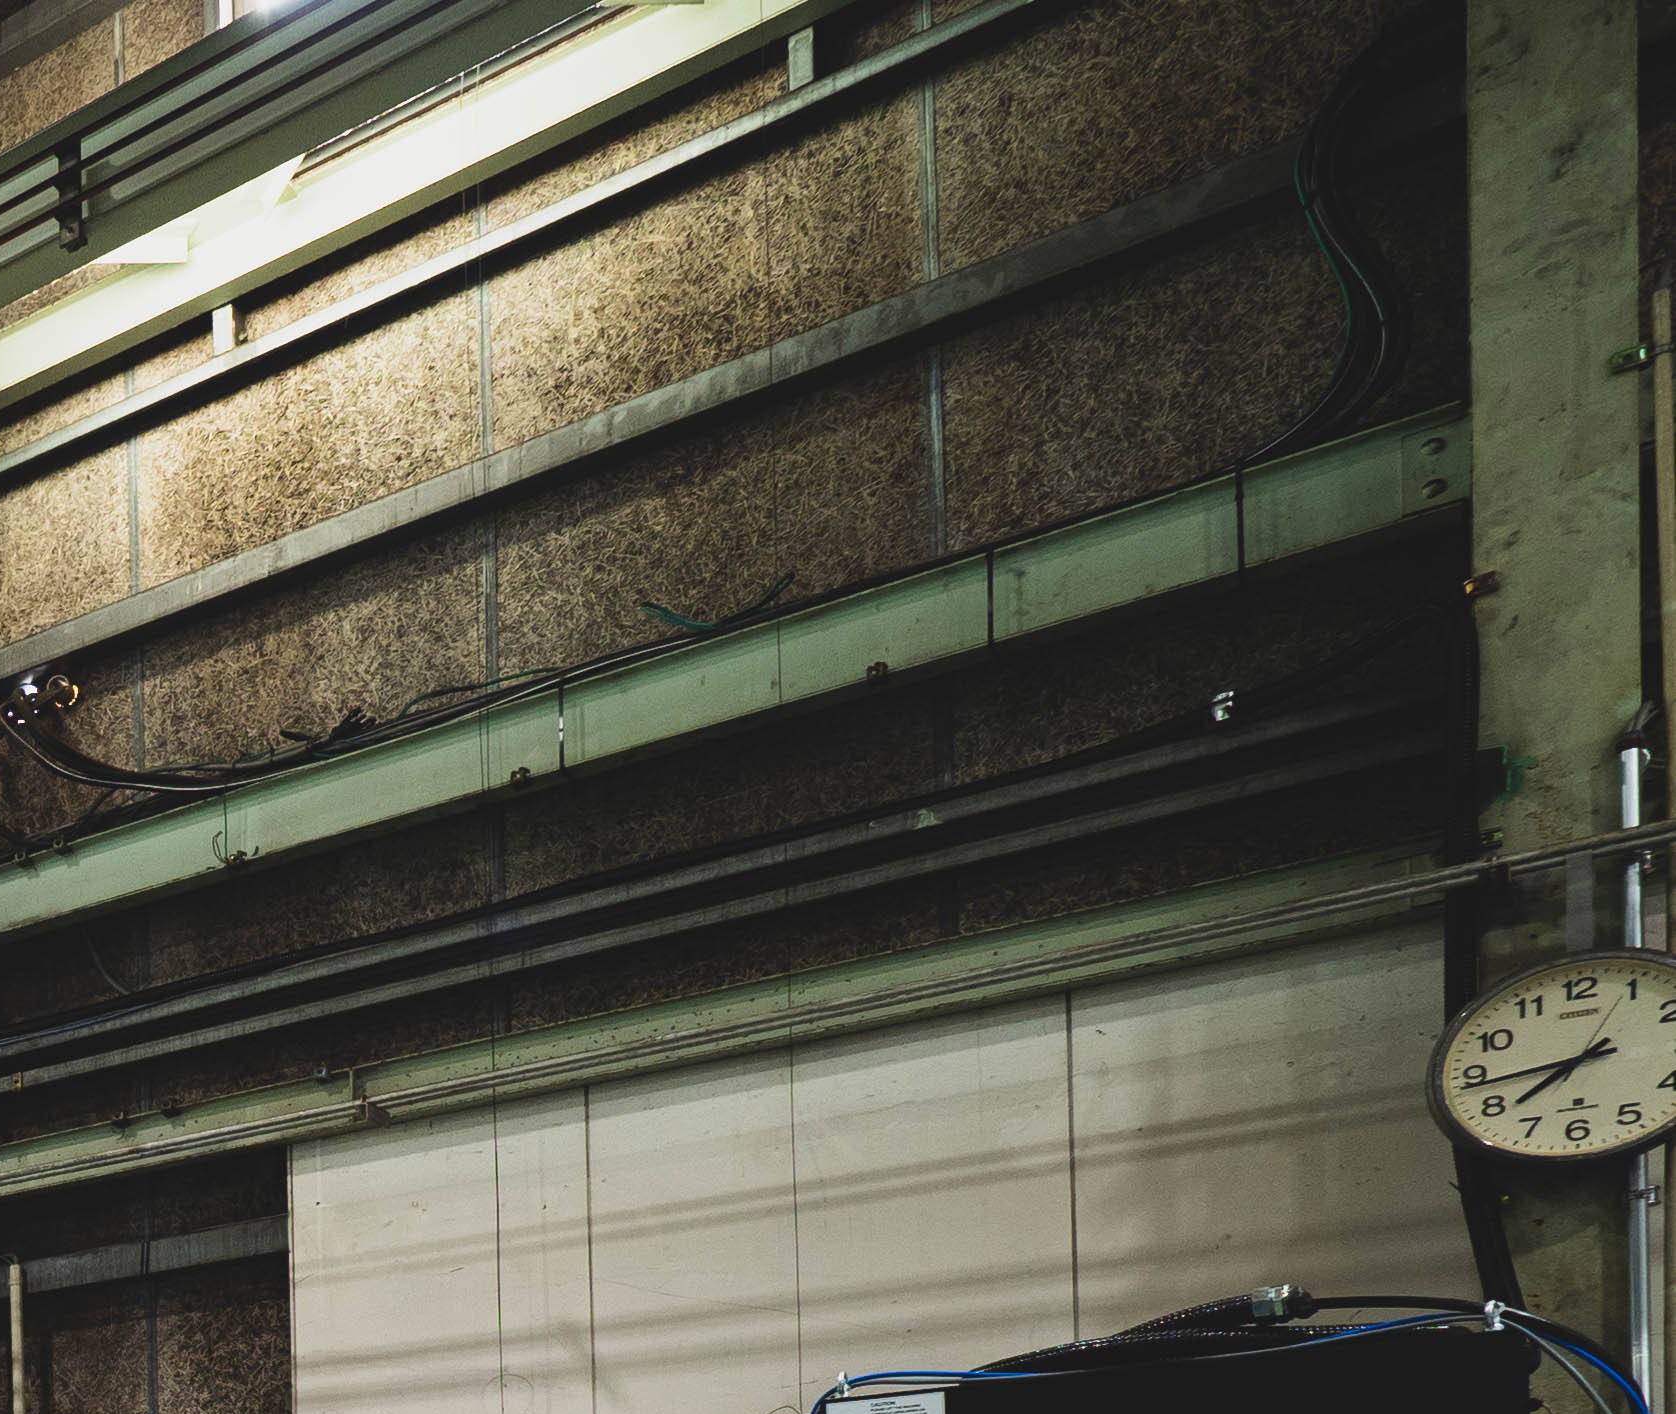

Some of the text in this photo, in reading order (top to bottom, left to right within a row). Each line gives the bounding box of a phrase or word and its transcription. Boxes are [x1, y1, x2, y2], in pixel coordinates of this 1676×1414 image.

[1561, 976, 1598, 1001] 12
[1625, 978, 1638, 1001] 1
[1514, 995, 1544, 1019] 11
[1476, 1028, 1514, 1053] 10
[1462, 1064, 1488, 1088] 9
[1656, 1069, 1676, 1092] 4
[1481, 1095, 1506, 1118] 8
[1616, 1102, 1643, 1126] 5
[1518, 1116, 1543, 1139] 7
[1564, 1119, 1591, 1142] 6
